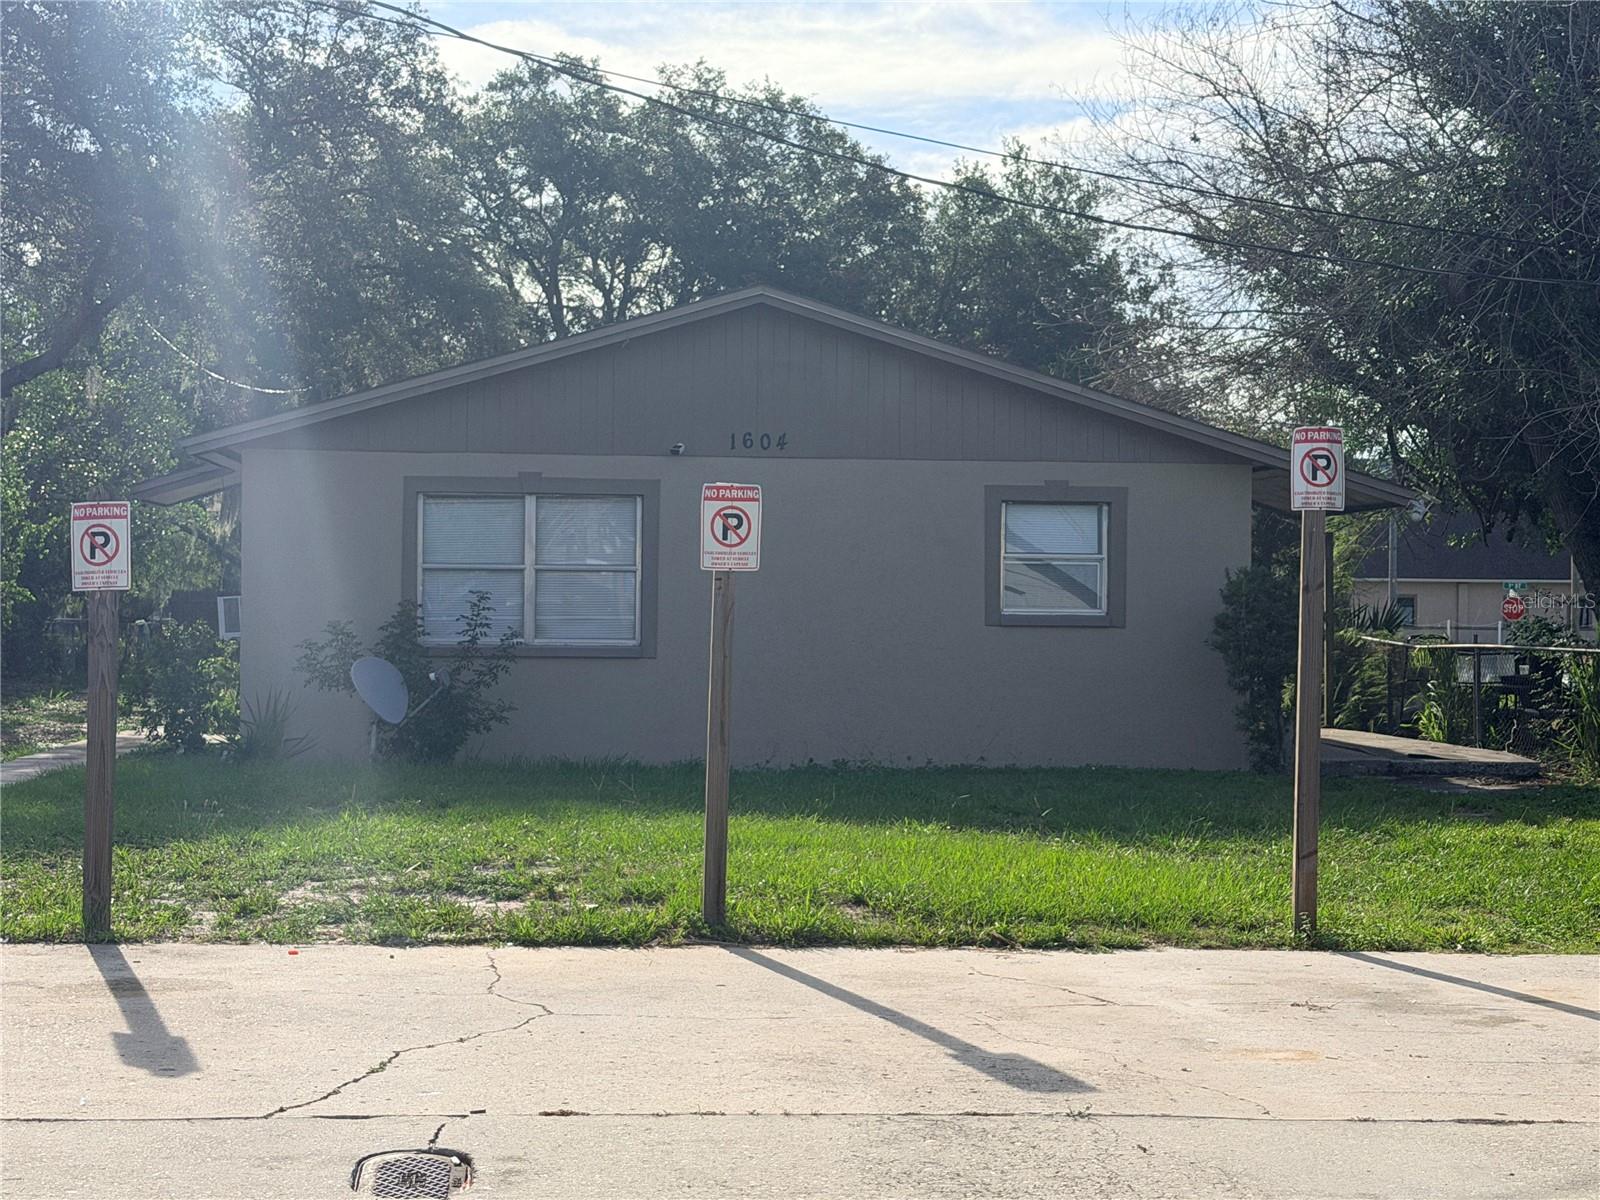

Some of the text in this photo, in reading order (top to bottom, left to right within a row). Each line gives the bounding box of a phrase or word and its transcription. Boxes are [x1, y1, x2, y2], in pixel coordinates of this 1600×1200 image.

[730, 432, 789, 450] 1604
[1296, 431, 1306, 440] NO
[705, 489, 759, 499] NO PARKING
[74, 506, 127, 517] NO PARKING
[1504, 603, 1524, 614] STOP
